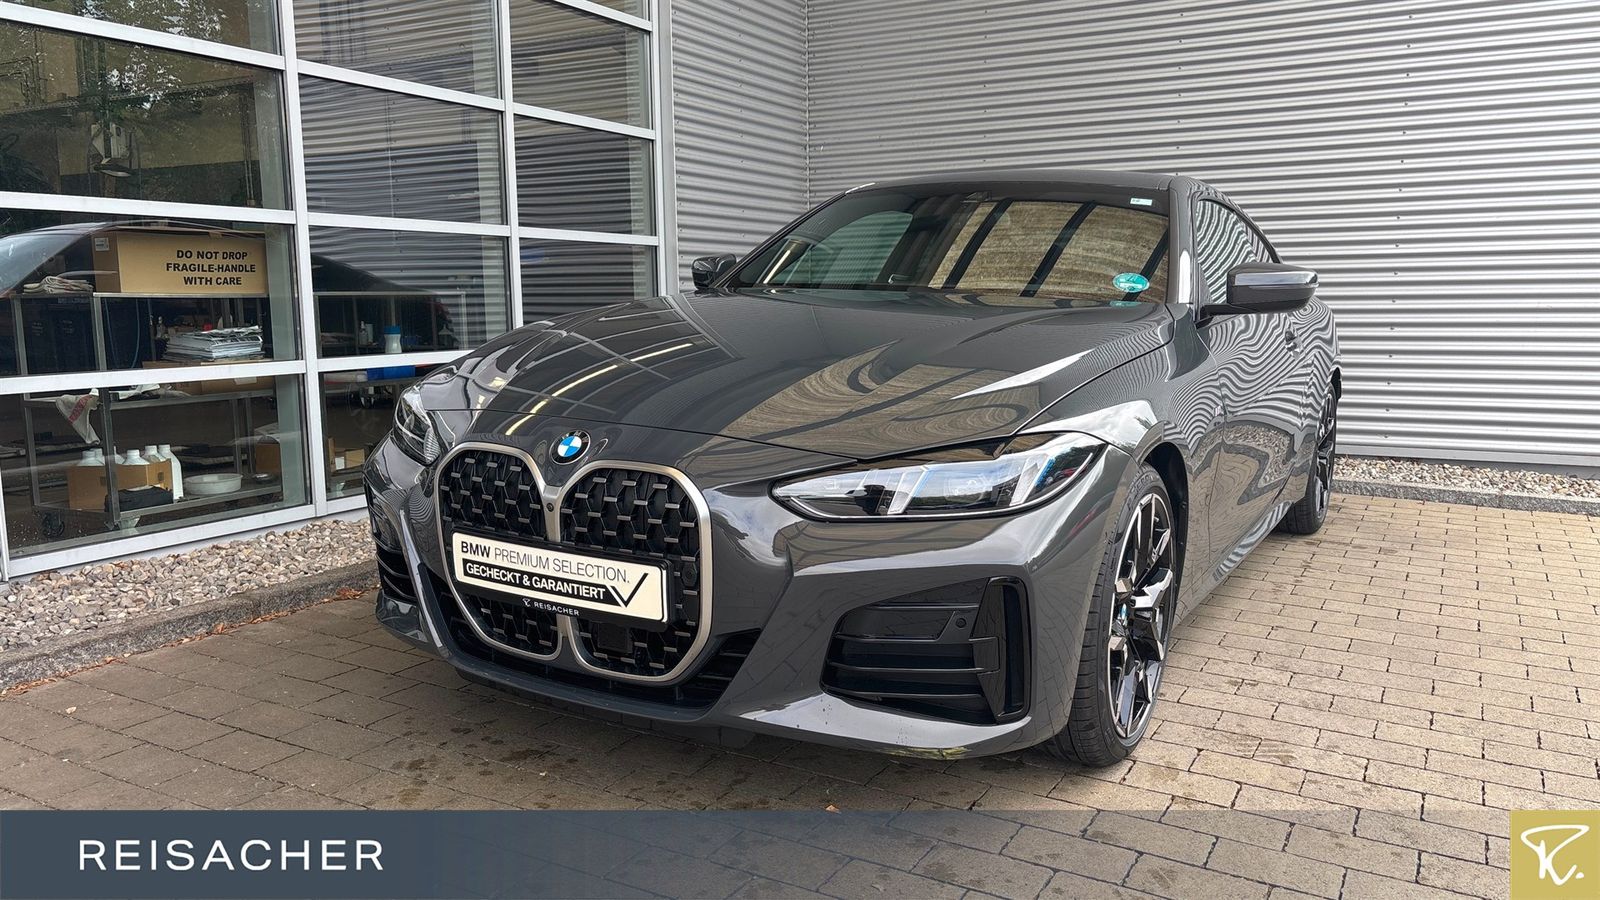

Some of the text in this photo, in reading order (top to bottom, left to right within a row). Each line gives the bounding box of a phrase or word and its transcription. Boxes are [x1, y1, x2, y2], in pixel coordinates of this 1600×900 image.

[176, 249, 248, 260] DO NOT DROP
[166, 262, 256, 273] FRAGILE-HANDLE
[183, 276, 242, 285] WITH CARE
[461, 541, 630, 583] BMW PREMIUM SELECTION.
[466, 563, 605, 600] GECHECKT & GARANTIERT
[533, 601, 580, 616] REISACHER
